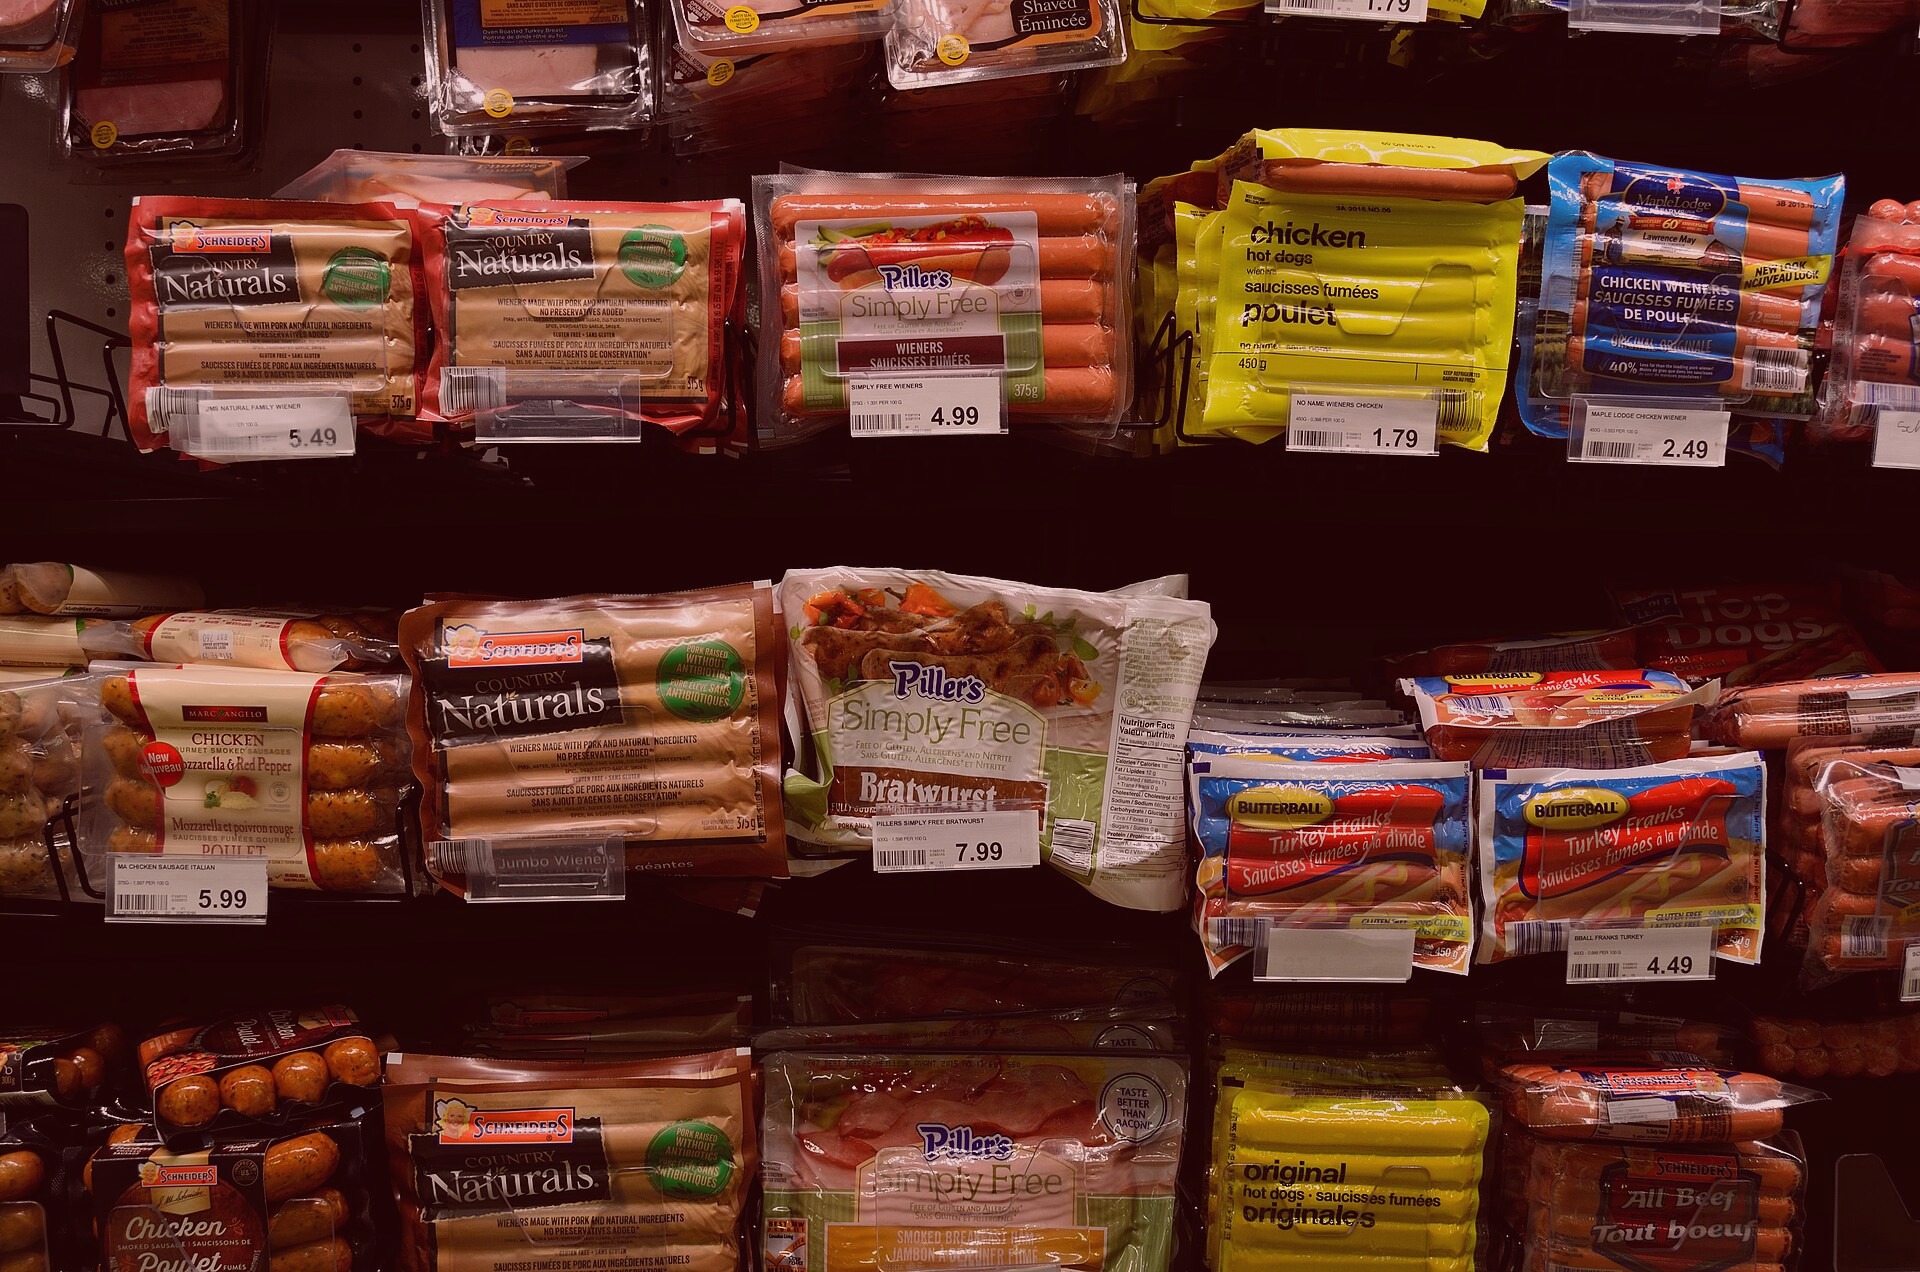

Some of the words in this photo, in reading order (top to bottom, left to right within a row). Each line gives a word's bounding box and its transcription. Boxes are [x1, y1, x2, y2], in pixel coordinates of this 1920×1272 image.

[1023, 0, 1077, 14] Shaved
[1019, 15, 1087, 33] Émincée
[485, 233, 554, 247] COUNTRY
[1250, 221, 1365, 249] chicken
[1643, 232, 1677, 243] Lawrence
[1679, 235, 1696, 245] May
[192, 258, 259, 273] COUNTRY
[457, 242, 582, 278] Naturals
[1246, 248, 1270, 262] hot
[1275, 250, 1313, 266] dogs
[880, 266, 951, 289] Piller's
[1744, 273, 1792, 289] NOUVEAU
[1794, 269, 1818, 281] LOOK
[1755, 265, 1779, 277] NEW
[164, 268, 287, 302] Naturals
[1245, 280, 1319, 296] saucisses
[1323, 283, 1378, 299] fumées
[1601, 275, 1661, 292] CHICKEN
[1665, 280, 1730, 296] WIENERS
[852, 296, 930, 318] Simply
[937, 292, 986, 313] Free
[1594, 291, 1672, 308] SAUCISSES
[1677, 293, 1734, 312] FUMÉES
[1242, 300, 1336, 326] poulet
[1624, 308, 1644, 321] DE
[1647, 309, 1701, 324] POULET
[896, 342, 943, 354] WIENERS
[870, 356, 926, 370] SAUCISSES
[930, 353, 970, 368] FUMÉES
[1609, 362, 1637, 374] 40%
[931, 406, 979, 425] 4.99
[289, 428, 336, 448] 5.49
[1373, 428, 1417, 448] 1.79
[1663, 439, 1708, 458] 2.49
[1683, 589, 1791, 623] Top
[1666, 617, 1824, 650] Dogs
[686, 654, 726, 667] WITHOUT
[475, 670, 567, 694] COUNTRY
[892, 664, 984, 701] Piller's
[666, 687, 729, 707] ANTIBIOTIQUES
[189, 709, 217, 719] MARC
[224, 709, 262, 719] ANGELO
[437, 681, 604, 734] Naturals
[844, 700, 955, 744] Simply
[961, 708, 1030, 744] Free
[1121, 716, 1154, 728] Nutrition
[192, 732, 264, 748] CHICKEN
[148, 751, 169, 763] New
[557, 752, 566, 761] NO
[568, 750, 624, 761] PRESERVATIVES
[237, 757, 255, 771] Red
[257, 759, 292, 775] Pepper
[859, 772, 997, 812] Bratwurst
[1238, 801, 1323, 815] BUTTERBALL
[1535, 801, 1619, 817] BUTTERBALL
[172, 818, 222, 833] Mozzarella
[224, 822, 232, 833] et
[234, 821, 267, 837] poivron
[269, 822, 294, 839] rouge
[1269, 829, 1326, 855] Turkey
[1332, 810, 1392, 837] Franks
[1564, 823, 1621, 857] Turkey
[1627, 805, 1685, 833] Franks
[499, 854, 549, 870] Jumbo
[554, 852, 615, 867] Wieners
[956, 842, 1003, 861] 7.99
[1243, 858, 1306, 888] Saucisses
[1310, 843, 1358, 868] fumées
[1386, 829, 1425, 850] dinde
[1538, 859, 1602, 890] Saucisses
[1606, 838, 1653, 868] fumées
[1656, 831, 1665, 846] à
[1665, 830, 1674, 844] la
[1678, 819, 1718, 841] dinde
[635, 860, 693, 871] géantes
[198, 890, 247, 908] 5.99
[1647, 956, 1692, 974] 4.49
[1120, 1088, 1147, 1097] TASTE
[1117, 1098, 1150, 1109] BETTER
[1121, 1109, 1146, 1118] THAN
[474, 1114, 568, 1138] SCHNEIDERS
[676, 1137, 716, 1150] WITHOUT
[695, 1131, 718, 1142] RAISED
[920, 1127, 1014, 1160] Piller's
[465, 1150, 557, 1168] COUNTRY
[1657, 1157, 1733, 1179] SCHNEIDERS
[161, 1169, 215, 1182] SCHNEIDERS
[991, 1163, 1063, 1195] Free
[1244, 1160, 1346, 1186] original
[426, 1161, 594, 1205] Naturals
[1244, 1184, 1266, 1200] hot
[1270, 1187, 1304, 1202] dogs
[1316, 1190, 1385, 1204] saucisses
[1389, 1194, 1440, 1206] fumées
[1622, 1187, 1664, 1209] All
[1675, 1187, 1738, 1211] Beef
[1243, 1204, 1376, 1230] originales
[126, 1216, 226, 1240] Chicken
[1592, 1224, 1657, 1243] Tout
[1667, 1220, 1759, 1242] boeuf
[151, 1241, 187, 1249] SAUSAGE
[192, 1239, 236, 1248] SAUCISSONS
[137, 1251, 222, 1272] Poulet
[223, 1262, 247, 1270] FUMÉS
